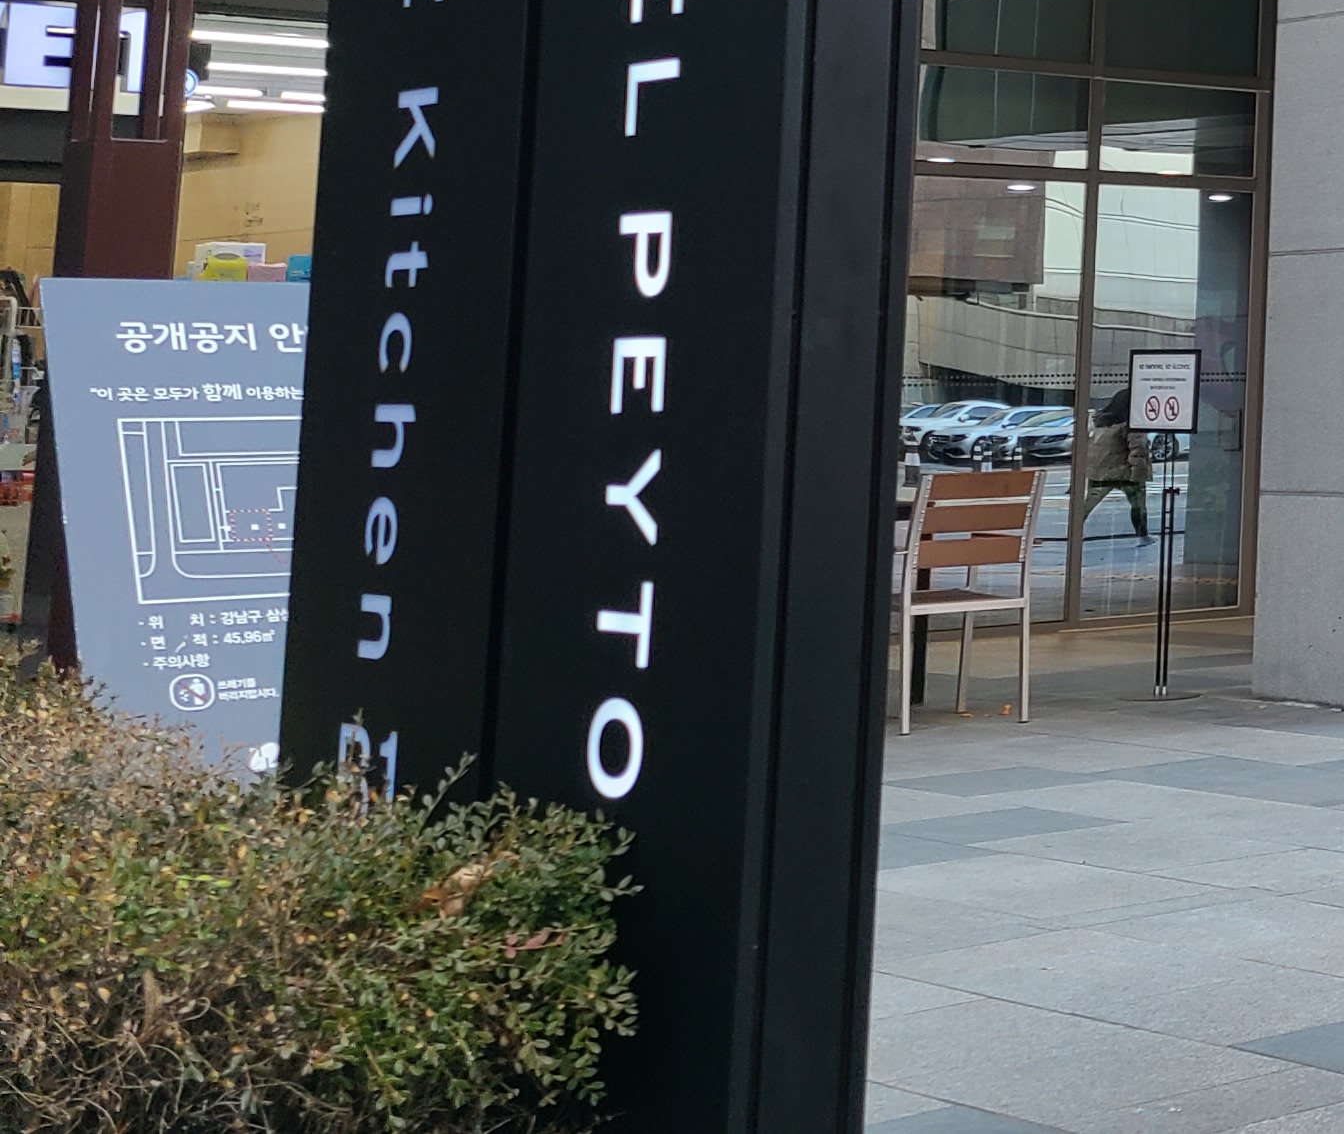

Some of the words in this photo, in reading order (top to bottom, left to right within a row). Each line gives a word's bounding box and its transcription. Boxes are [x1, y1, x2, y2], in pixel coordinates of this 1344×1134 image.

[115, 322, 258, 355] 공개공지
[268, 322, 309, 353] 안
[356, 87, 439, 660] Kitchen
[118, 387, 150, 402] 곳은
[153, 387, 199, 401] 모두가
[201, 383, 243, 402] 함께
[245, 386, 304, 401] 이용하는
[586, 210, 673, 800] PEYTO
[220, 610, 264, 627] 강남구
[152, 654, 211, 670] 주의사항
